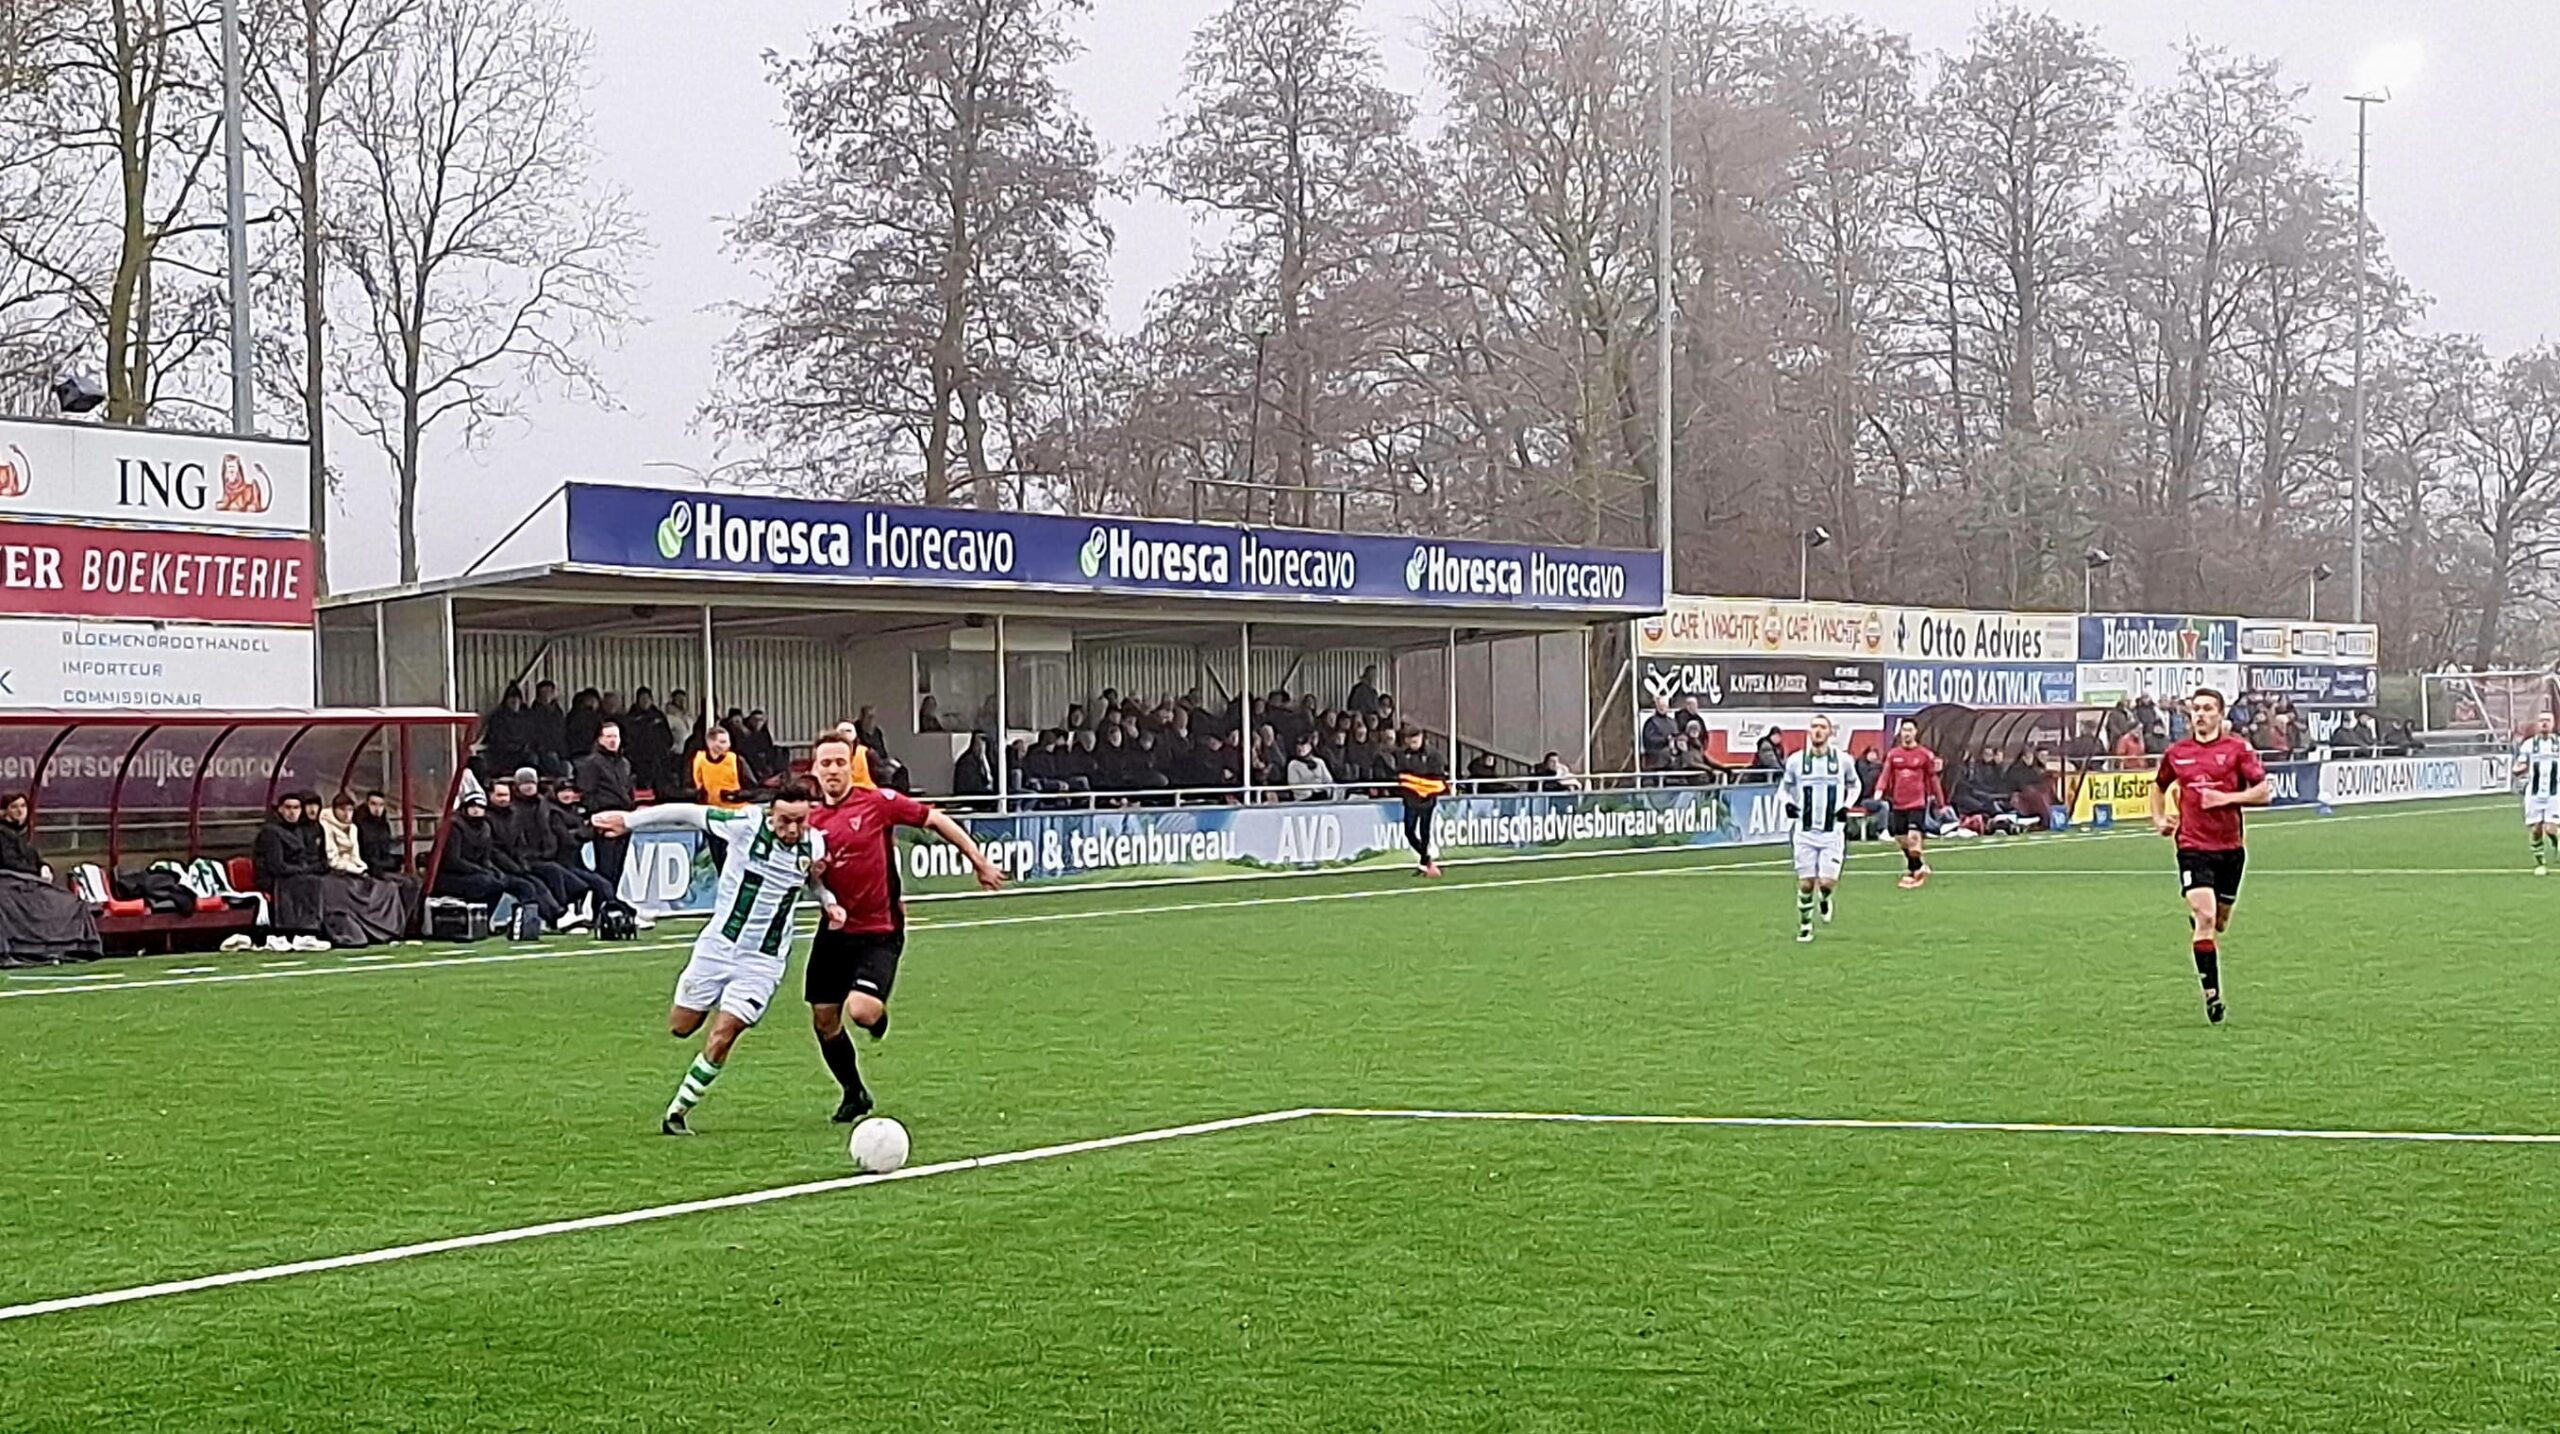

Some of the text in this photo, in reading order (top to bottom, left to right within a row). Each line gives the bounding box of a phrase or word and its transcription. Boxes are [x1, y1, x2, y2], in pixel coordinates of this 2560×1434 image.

[116, 458, 207, 511] ING
[696, 504, 1014, 574] Horesca Horecavo
[1109, 526, 1355, 589] Horesca Horecavo
[0, 545, 301, 599] ER BOEKETTERIE
[1428, 545, 1625, 599] Horesca Horecavo
[1920, 616, 1966, 656] Otto
[1974, 615, 2042, 658] Advies
[2103, 618, 2179, 660] Heineken
[63, 661, 163, 677] IMPORTEUR
[1681, 665, 1722, 703] CARL
[1887, 668, 1938, 704] KAREL
[1940, 668, 1974, 702] OTO
[1976, 670, 2043, 704] KATWIJK
[63, 689, 202, 705] COMMISSIONAIR
[2336, 764, 2389, 796] BOUWEN
[2391, 762, 2415, 792] AAN
[2417, 760, 2463, 791] MORGEN
[1042, 830, 1065, 869] &
[1071, 825, 1237, 868] tekenbureau
[1277, 814, 1342, 863] AVD
[1374, 799, 1717, 850] wwtechnischadviesbureau-avd.nl
[625, 842, 691, 902] VD
